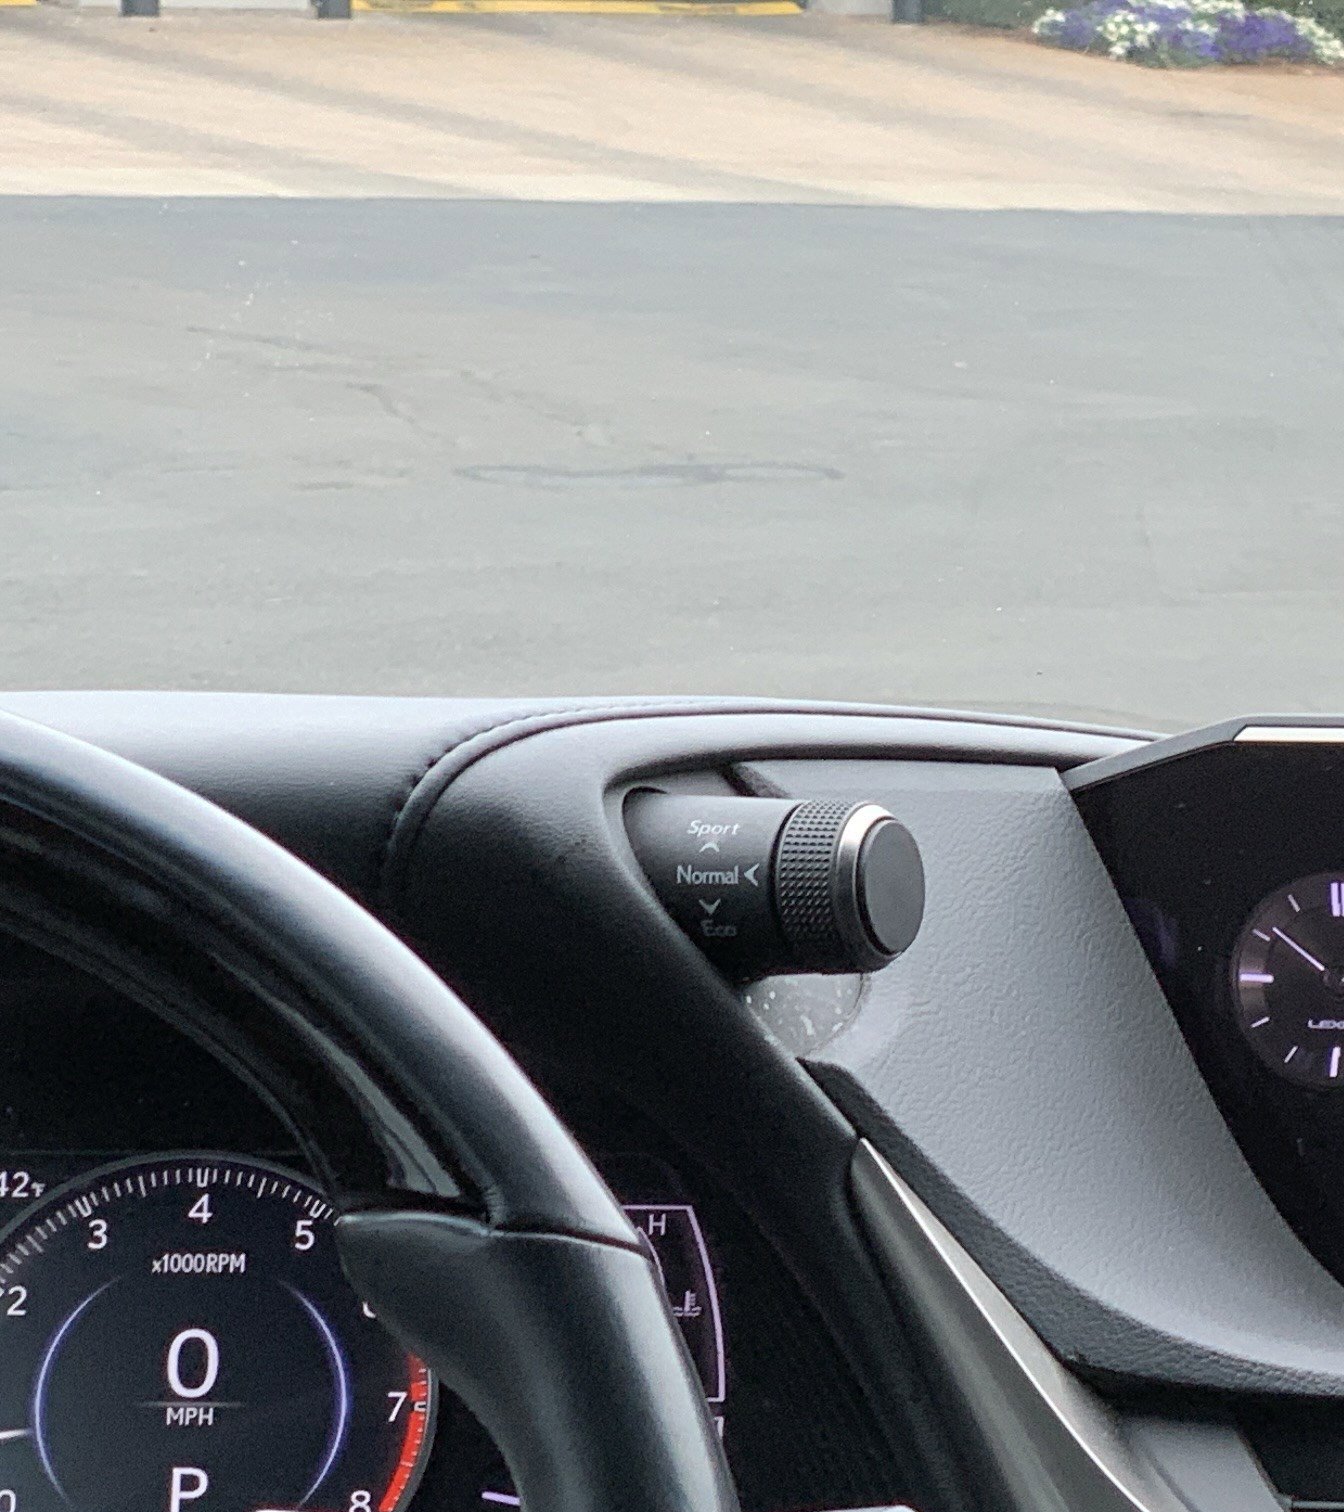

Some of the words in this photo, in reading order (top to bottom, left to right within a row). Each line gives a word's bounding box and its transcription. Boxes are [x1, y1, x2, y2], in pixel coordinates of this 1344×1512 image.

[687, 819, 740, 836] Sport
[676, 865, 739, 886] Normal
[188, 1194, 212, 1224] 4
[87, 1220, 109, 1249] 3
[295, 1219, 315, 1249] 5
[648, 1213, 667, 1236] H
[152, 1253, 246, 1275] x1000RPM
[7, 1287, 27, 1316] 2
[165, 1328, 220, 1399] 0
[166, 1407, 214, 1427] MPH
[388, 1391, 406, 1422] 7
